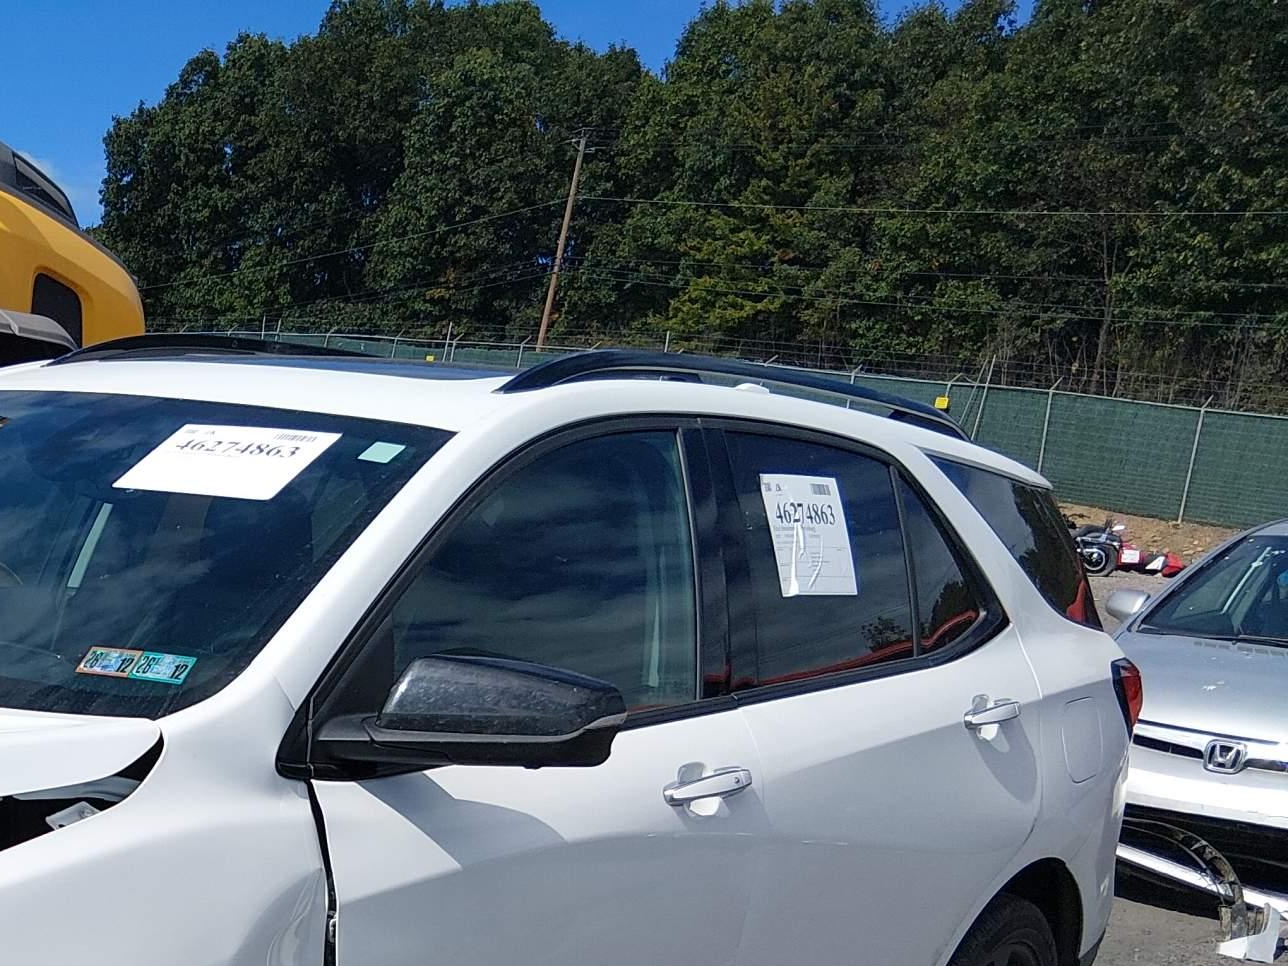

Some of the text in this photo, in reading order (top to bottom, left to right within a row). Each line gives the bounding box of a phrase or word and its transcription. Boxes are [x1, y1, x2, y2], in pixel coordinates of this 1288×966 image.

[176, 439, 301, 458] 46274863
[776, 503, 836, 525] 46274863
[116, 657, 134, 673] 12
[170, 663, 189, 680] 12
